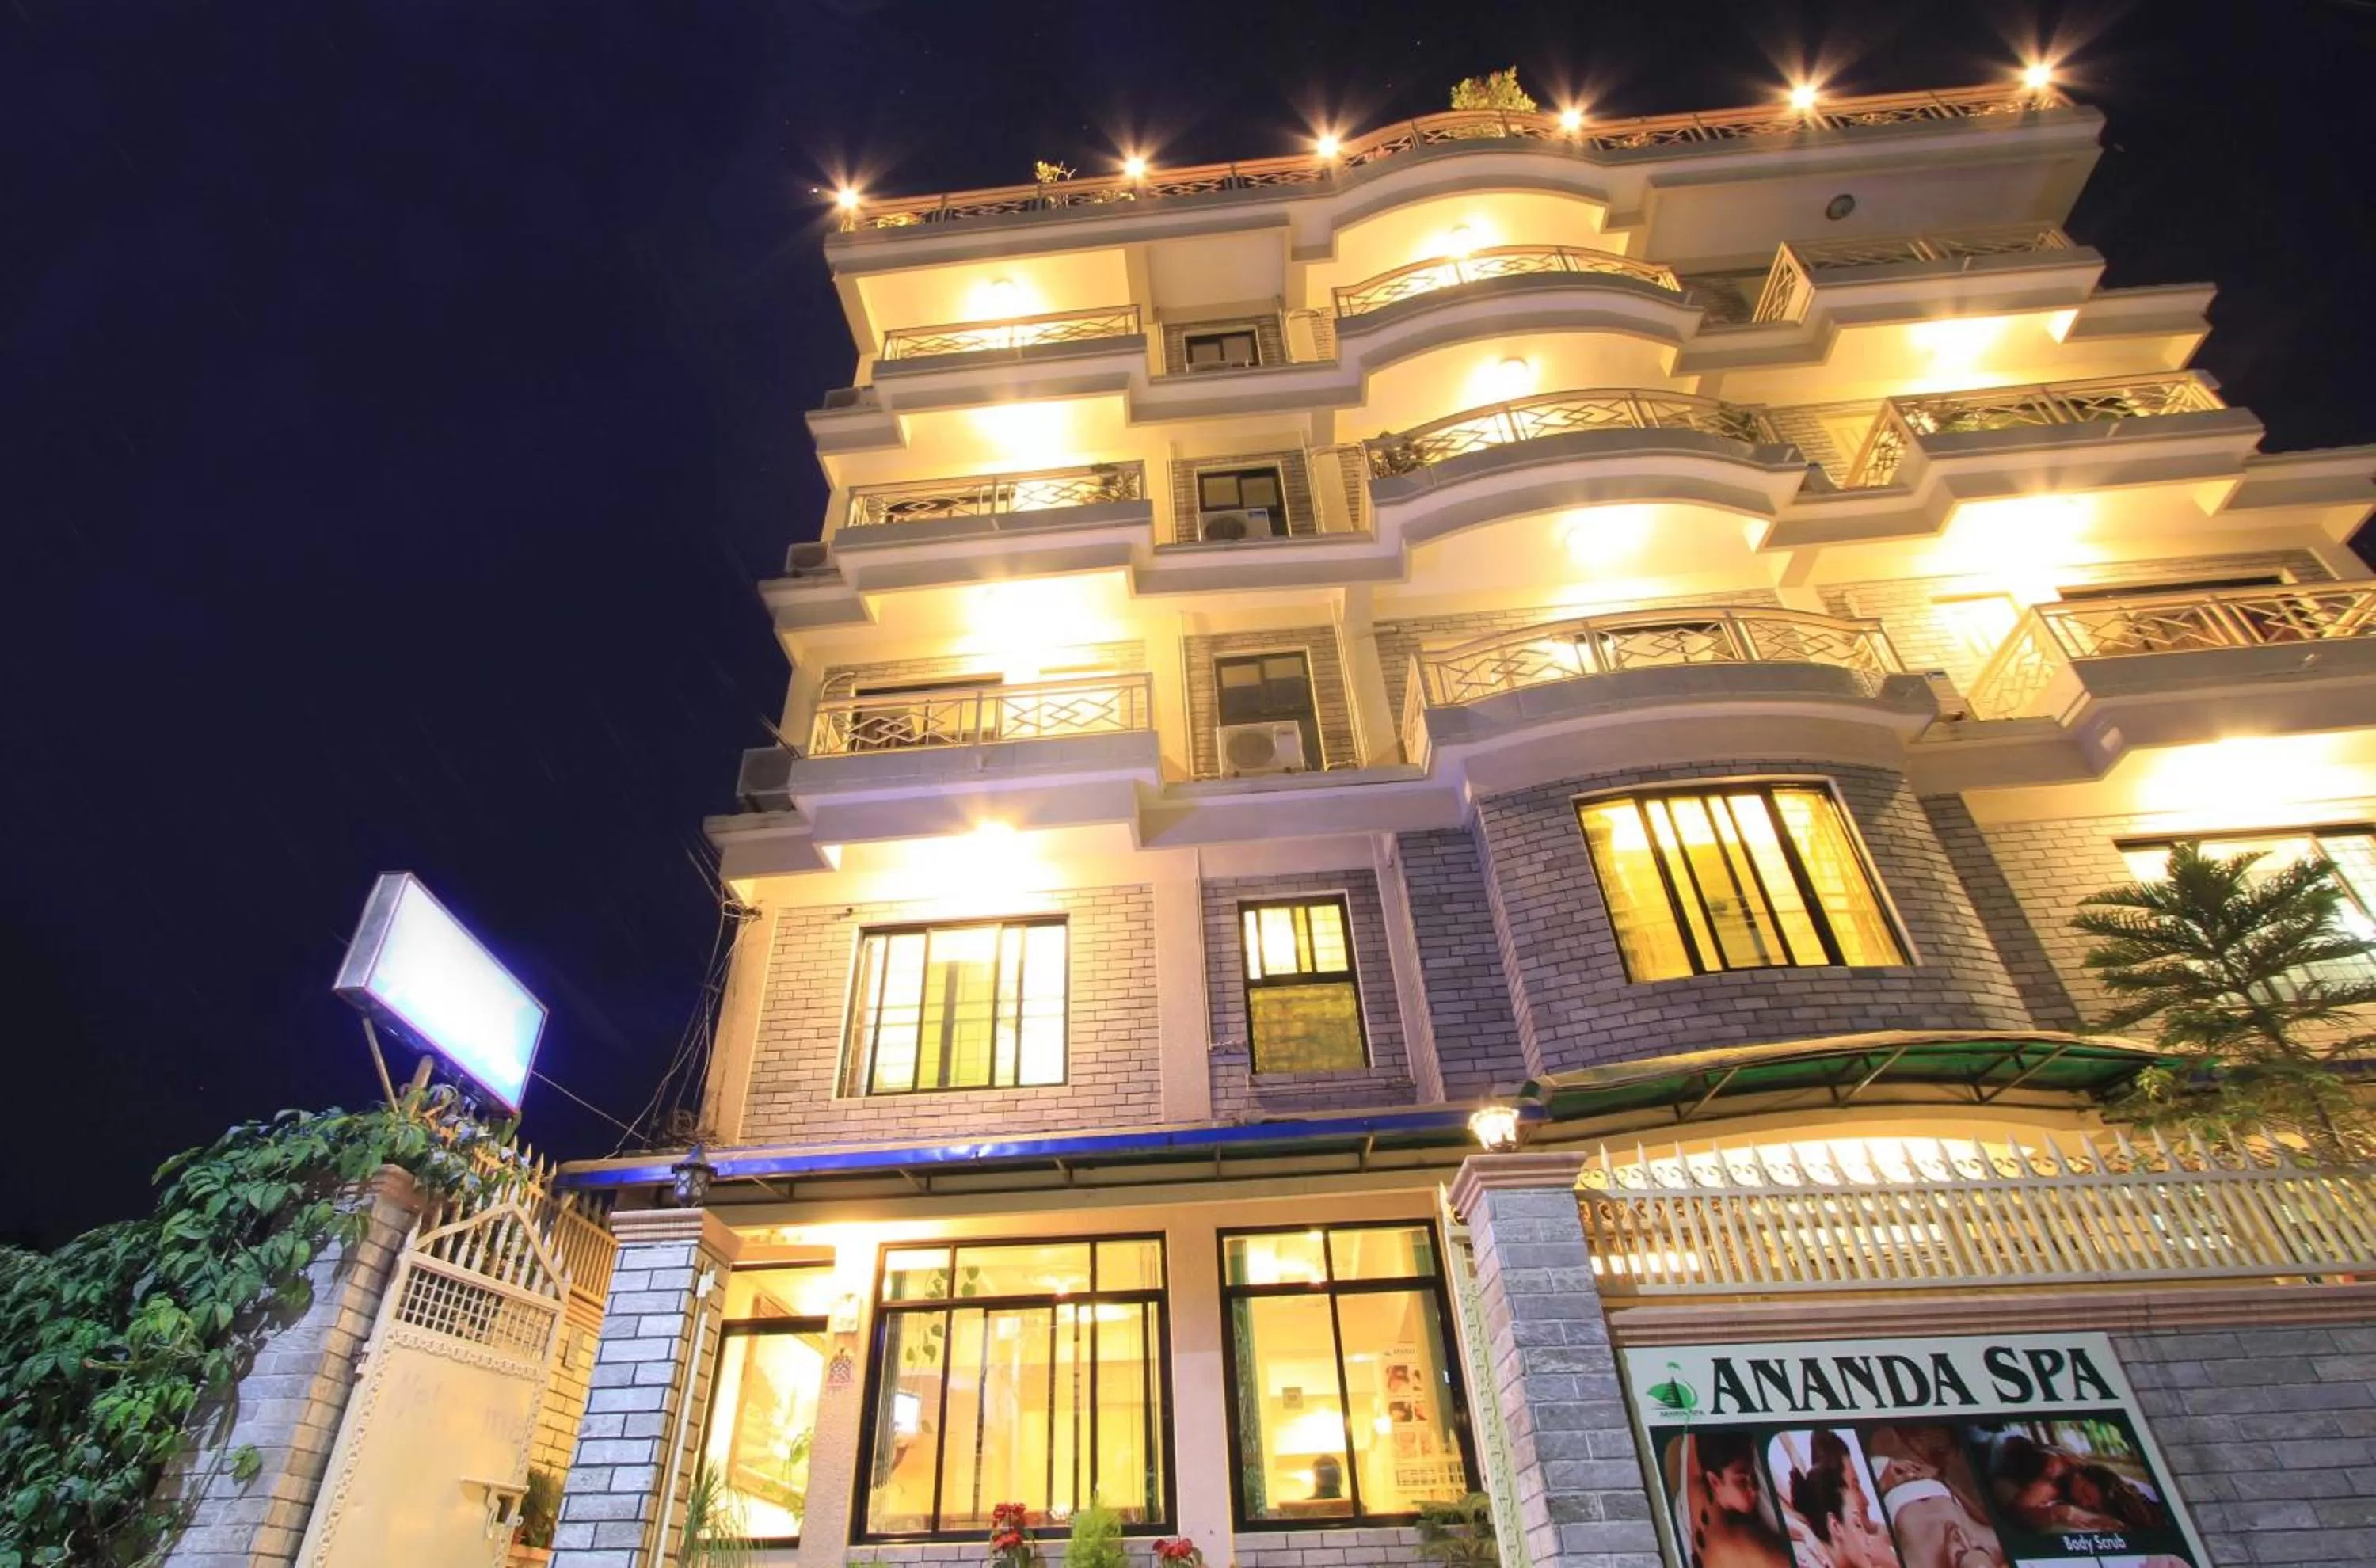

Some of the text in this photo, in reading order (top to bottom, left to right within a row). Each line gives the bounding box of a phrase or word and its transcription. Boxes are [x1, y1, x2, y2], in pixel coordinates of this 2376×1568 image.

[1711, 1346, 2120, 1414] ANANDA SPA
[2062, 1532, 2127, 1554] Body Scrub
